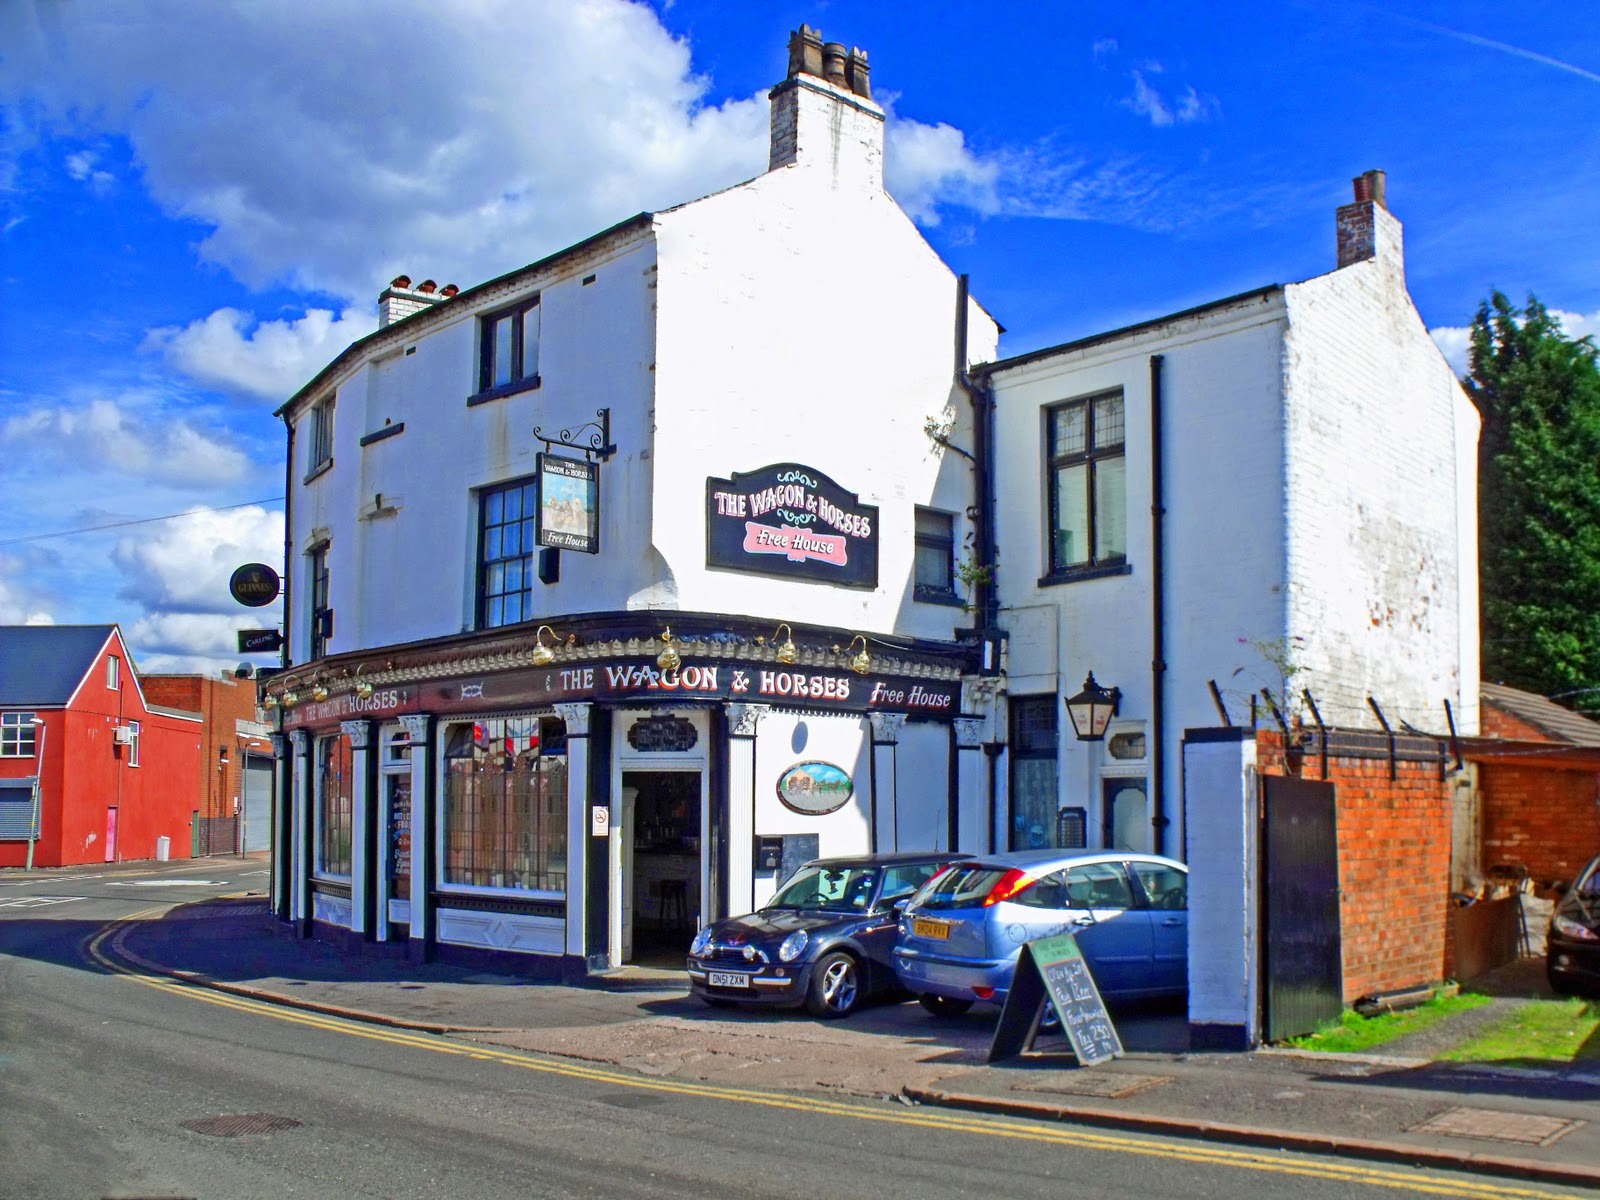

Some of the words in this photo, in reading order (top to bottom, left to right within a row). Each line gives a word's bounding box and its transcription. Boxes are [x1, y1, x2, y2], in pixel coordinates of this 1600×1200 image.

[545, 464, 564, 475] WAGON
[714, 491, 746, 517] THE
[749, 484, 805, 517] WAGON
[806, 494, 817, 514] &
[818, 496, 871, 538] HORSES
[548, 532, 562, 543] Free
[565, 535, 588, 547] House
[757, 529, 788, 547] Free
[792, 535, 834, 554] House
[238, 582, 274, 593] GUINNESS
[561, 667, 594, 692] THE
[606, 664, 718, 692] WAGON
[733, 670, 750, 692] &
[760, 670, 850, 699] HORSES
[870, 682, 904, 703] Free
[908, 685, 951, 707] House
[306, 705, 316, 722] THE
[318, 699, 341, 719] WAGON
[349, 690, 398, 713] HORSES
